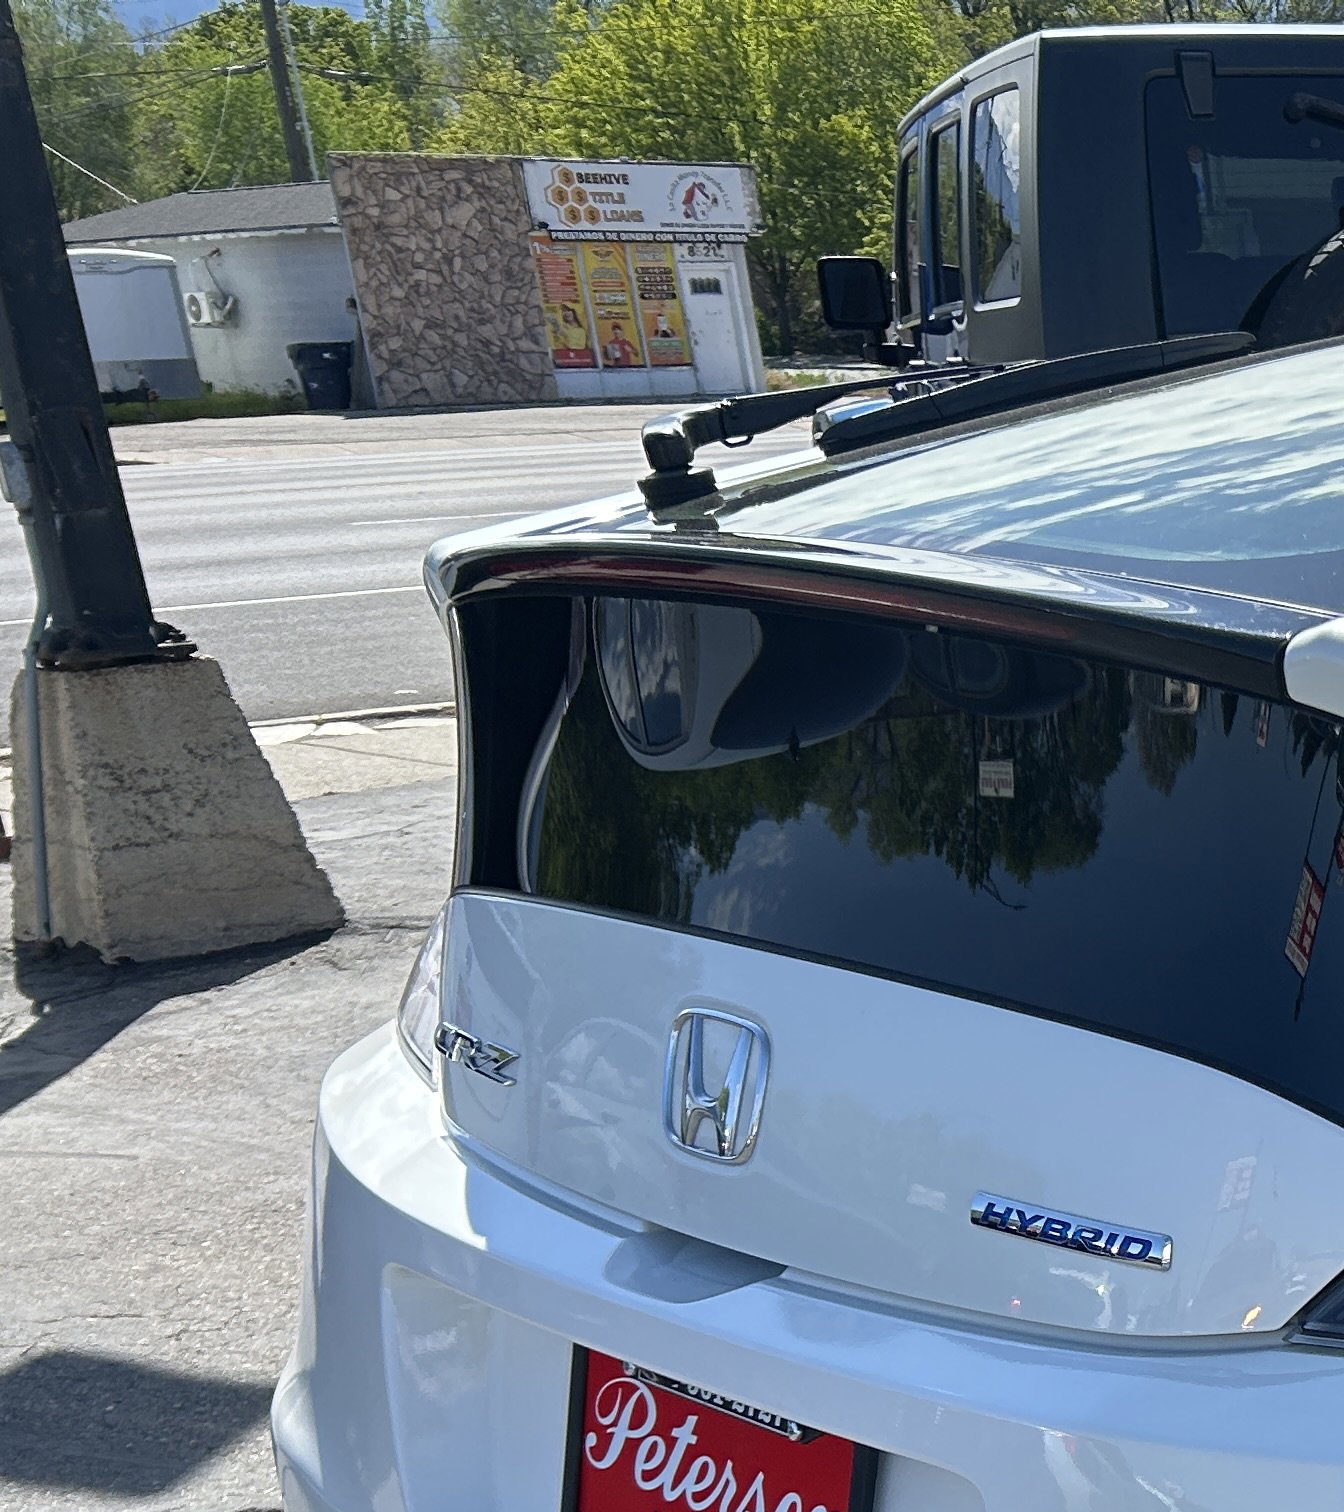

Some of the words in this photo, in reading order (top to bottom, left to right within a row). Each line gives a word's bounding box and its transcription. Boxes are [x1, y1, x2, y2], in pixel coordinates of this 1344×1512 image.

[575, 172, 630, 186] BEEHIVE
[588, 191, 625, 204] TITLE
[602, 209, 645, 222] LOANS
[551, 231, 605, 240] PRESTAMOS
[619, 232, 654, 241] DINERO
[978, 1201, 1154, 1263] HYBRID
